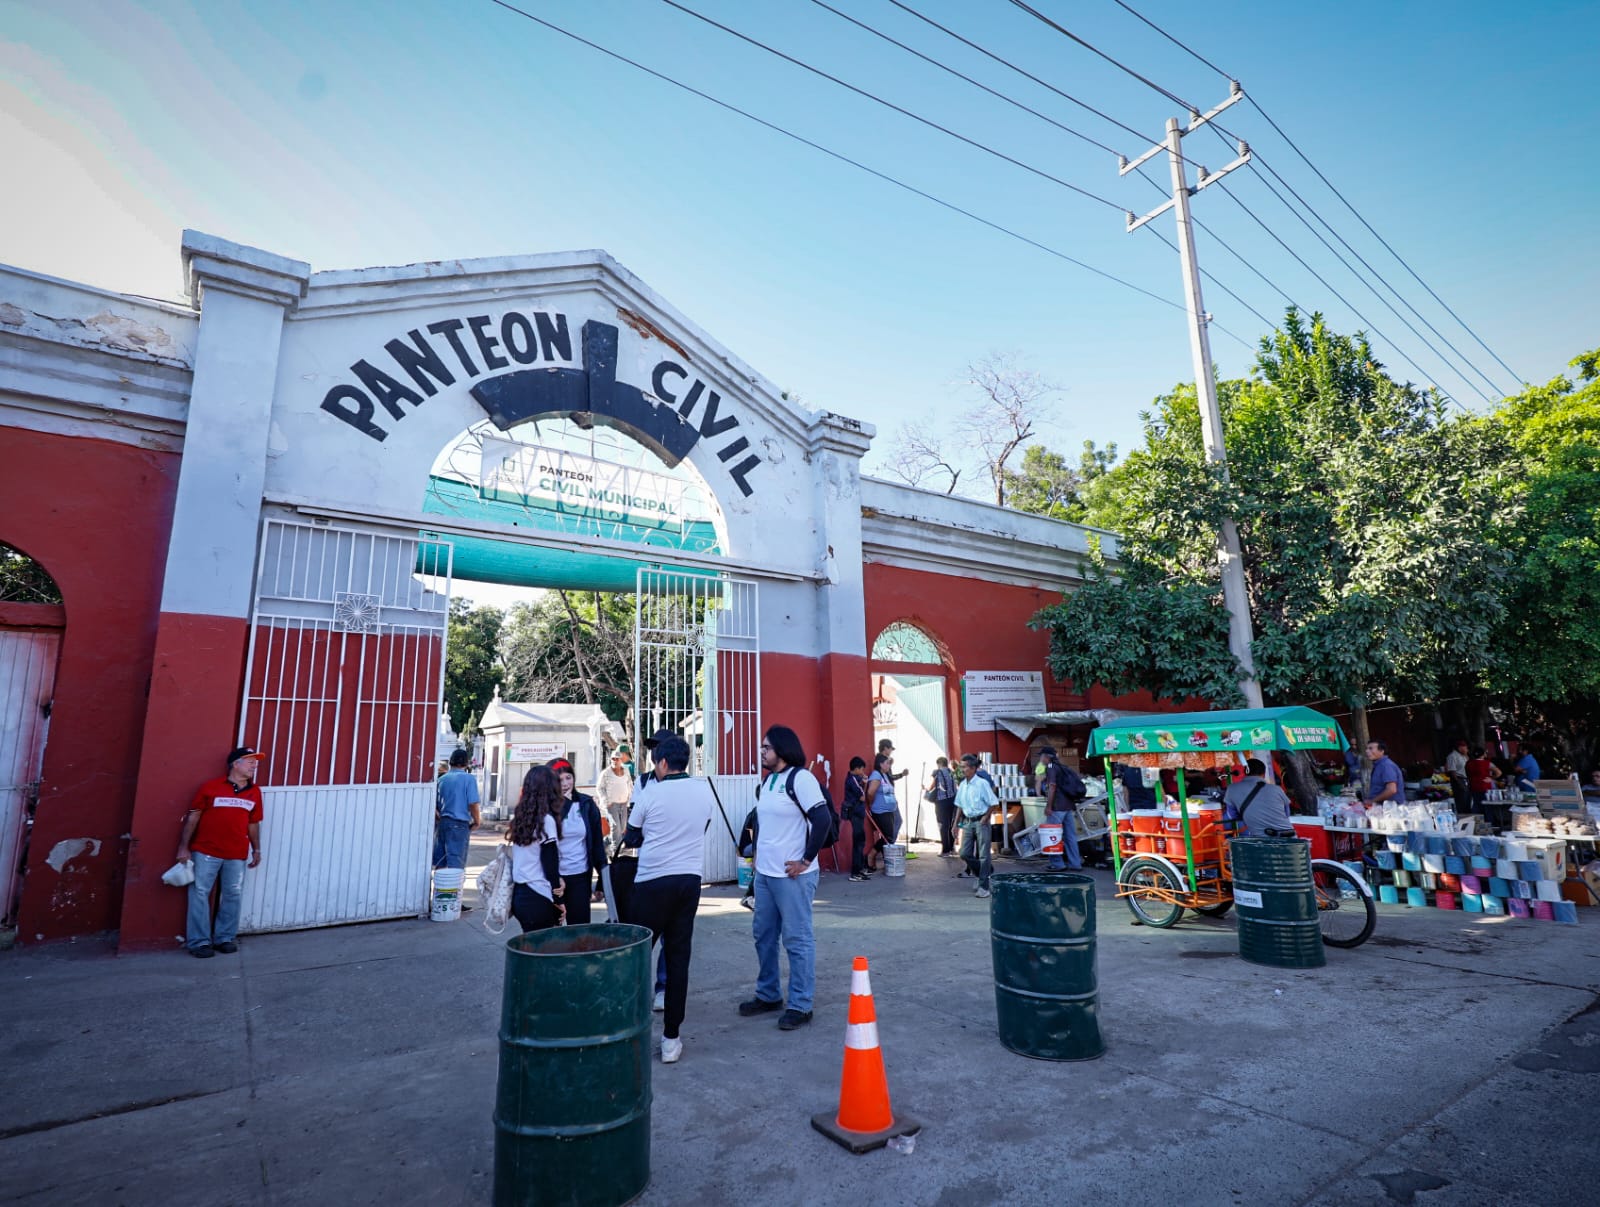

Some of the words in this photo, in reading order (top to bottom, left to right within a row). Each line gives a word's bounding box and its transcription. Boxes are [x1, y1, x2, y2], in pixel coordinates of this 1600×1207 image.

[320, 312, 572, 442] PANTEON
[651, 360, 762, 498] CIVIL
[539, 465, 593, 483] PANTEON
[539, 478, 585, 498] CIVIL
[589, 489, 677, 515] MUNICIPAL
